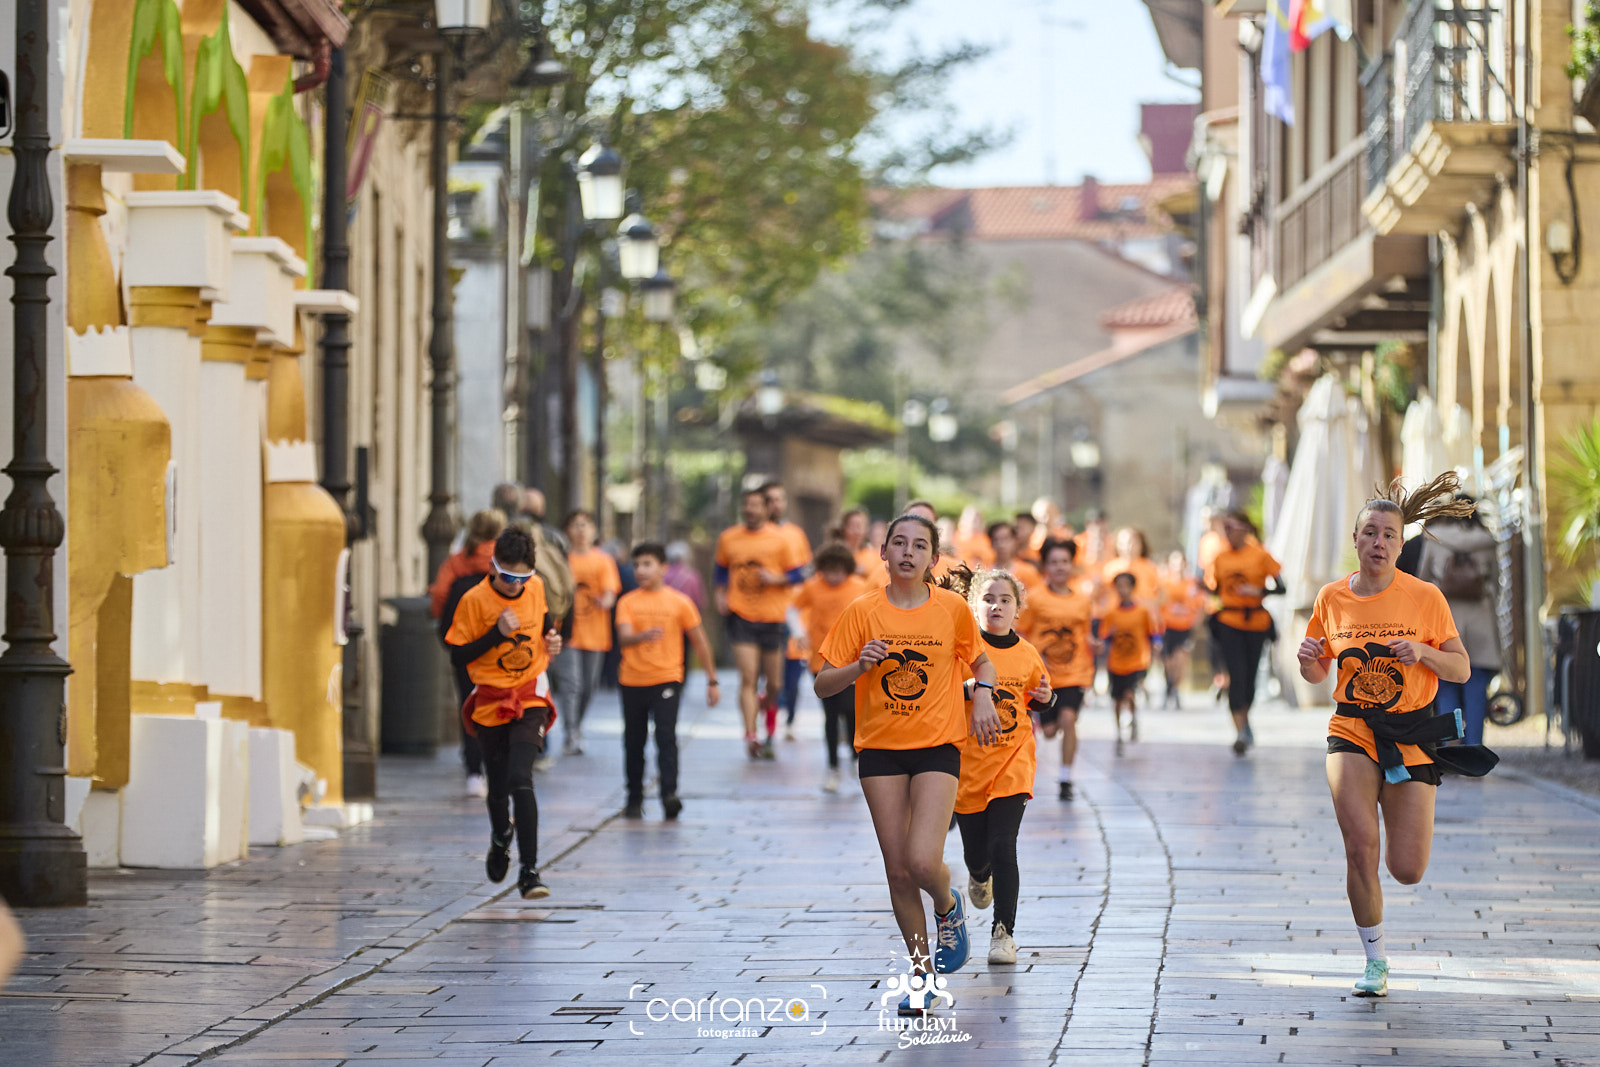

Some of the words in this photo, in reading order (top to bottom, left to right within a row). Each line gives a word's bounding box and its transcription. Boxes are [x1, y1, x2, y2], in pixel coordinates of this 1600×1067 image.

[1356, 630, 1376, 639] CON
[1379, 628, 1417, 638] GALBÁN
[914, 639, 943, 647] GALBÁN
[884, 702, 920, 711] galbán
